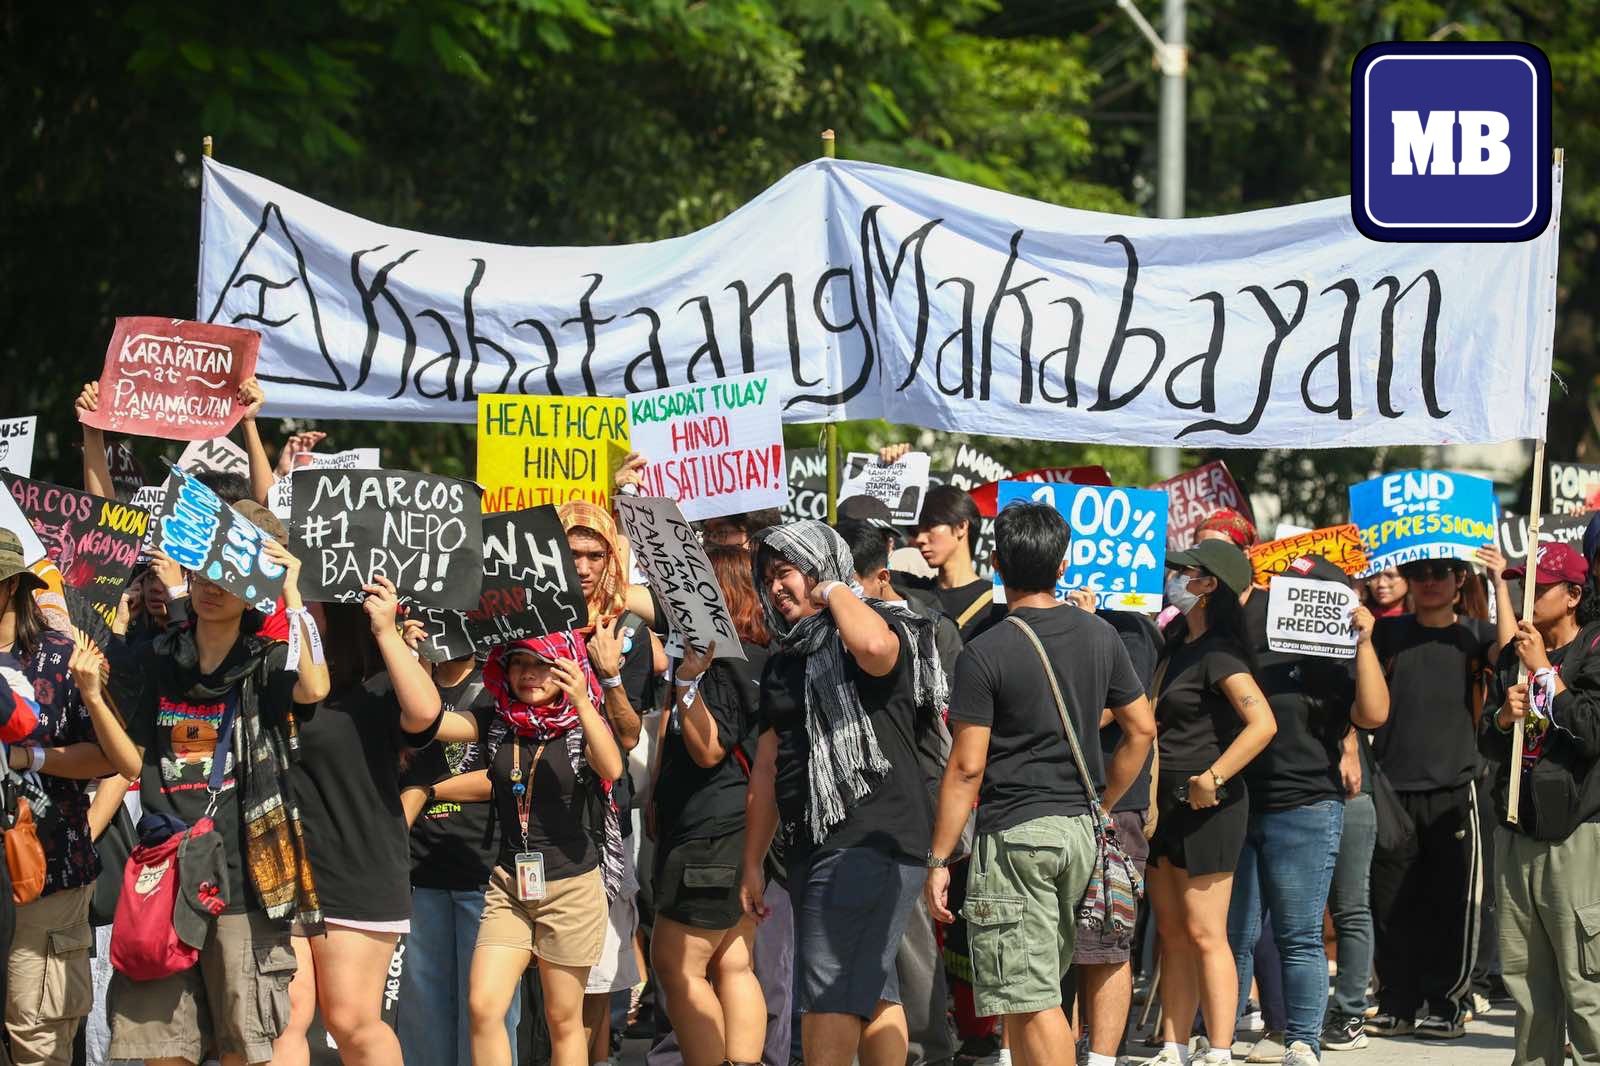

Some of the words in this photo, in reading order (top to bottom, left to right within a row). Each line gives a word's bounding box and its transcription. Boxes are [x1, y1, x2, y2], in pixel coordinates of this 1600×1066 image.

[350, 243, 876, 412] Kabataang
[860, 204, 1452, 440] Makabayan
[119, 335, 233, 374] KARAPATAN
[153, 366, 182, 384] at
[711, 377, 768, 410] TULAY
[0, 420, 29, 438] USE
[486, 402, 628, 441] HEALTHCAR
[671, 415, 731, 454] HINDI
[524, 446, 596, 482] HINDI
[12, 480, 93, 522] ARCOS
[308, 474, 464, 514] MARCOS
[865, 482, 900, 490] STARTING
[1382, 472, 1455, 508] END
[98, 501, 149, 537] NOON
[1391, 500, 1441, 517] THE
[78, 529, 142, 569] NGAYON
[300, 510, 355, 549] #1
[382, 510, 467, 553] NEPO
[322, 547, 451, 592] BABY!!
[1287, 587, 1349, 606] DEFEND
[1293, 603, 1342, 620] PRESS
[1276, 616, 1354, 637] FREEDOM
